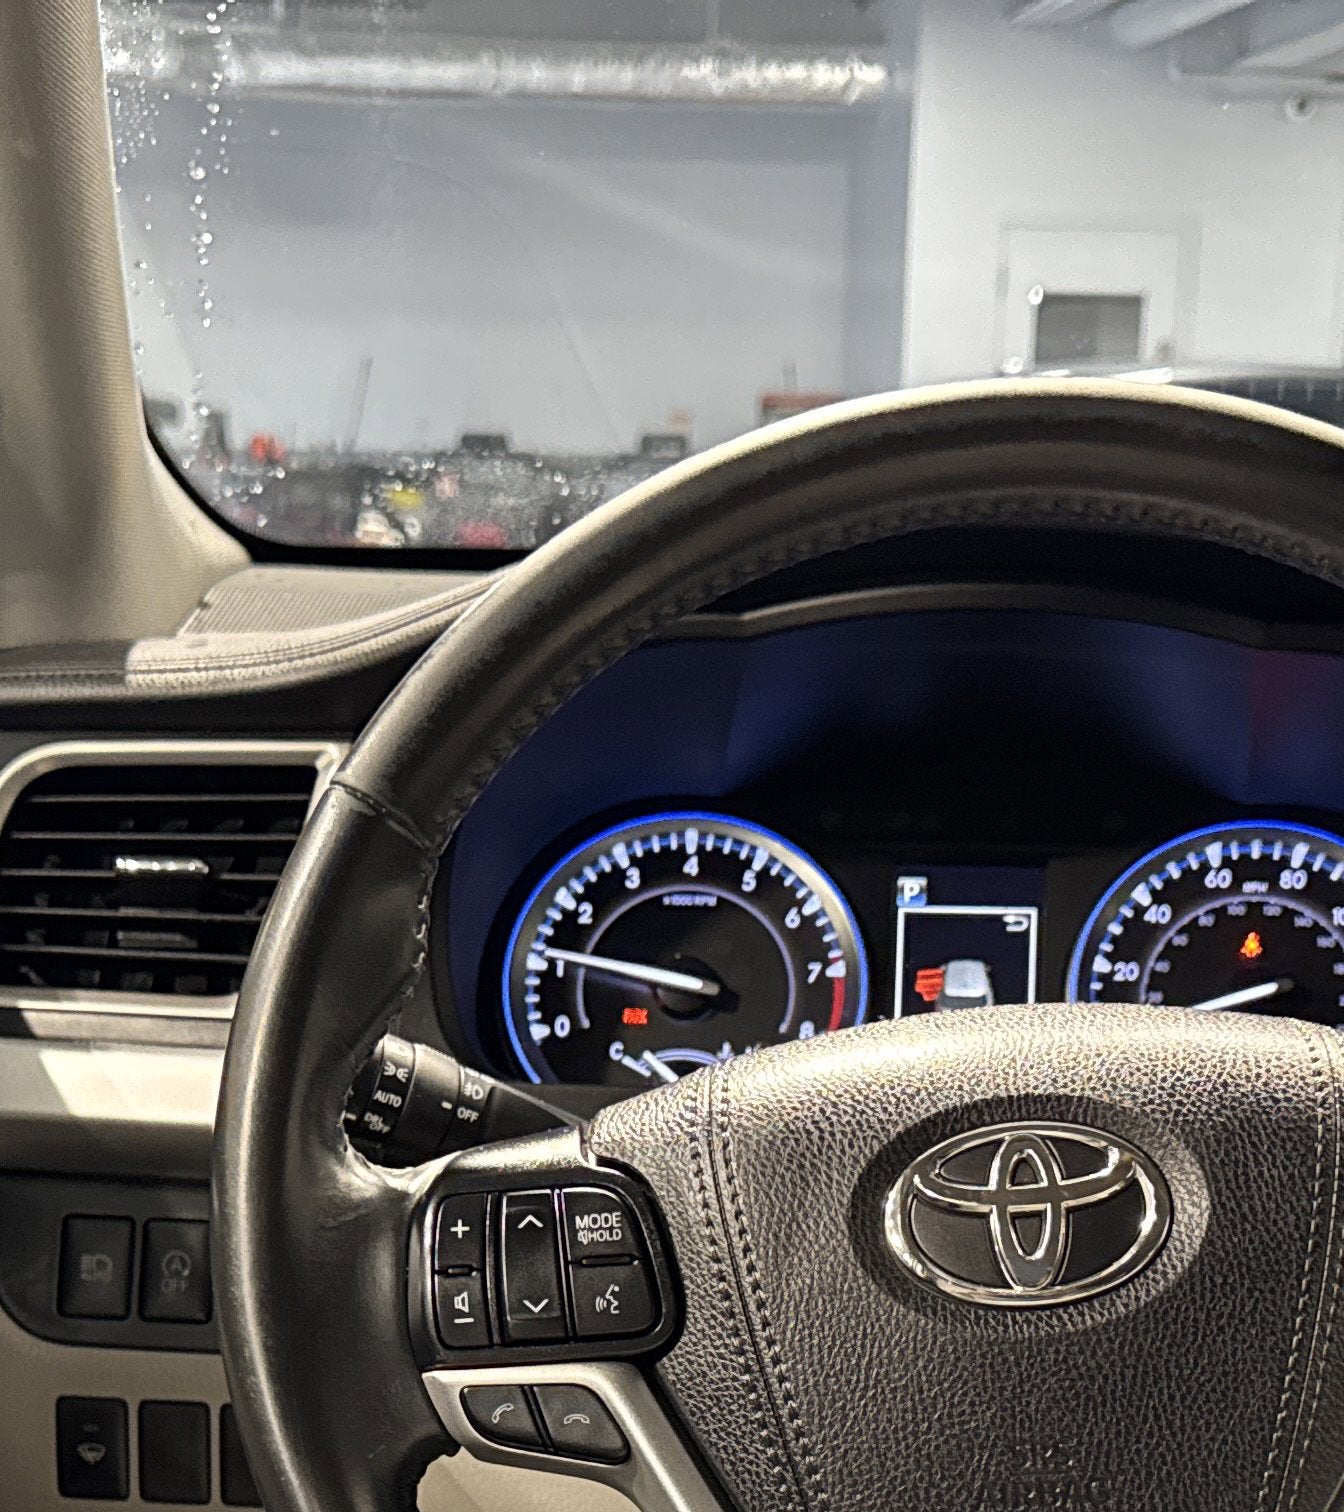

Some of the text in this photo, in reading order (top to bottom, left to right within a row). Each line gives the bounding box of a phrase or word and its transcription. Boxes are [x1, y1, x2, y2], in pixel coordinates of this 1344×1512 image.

[683, 855, 699, 877] 4
[624, 866, 641, 890] 3
[742, 869, 757, 892] 5
[1204, 868, 1233, 890] 60
[1279, 868, 1308, 890] 80
[903, 881, 921, 904] P
[577, 901, 594, 925] 2
[784, 906, 802, 930] 6
[1143, 903, 1173, 925] 40
[807, 961, 823, 984] 7
[1113, 960, 1141, 983] 20
[554, 1014, 571, 1038] 0
[609, 1040, 625, 1061] C
[372, 1089, 403, 1109] AUTO
[363, 1111, 384, 1125] DRL
[456, 1107, 480, 1123] OFF
[368, 1121, 391, 1134] OFF
[575, 1211, 622, 1230] MODE
[587, 1228, 622, 1243] HOLD
